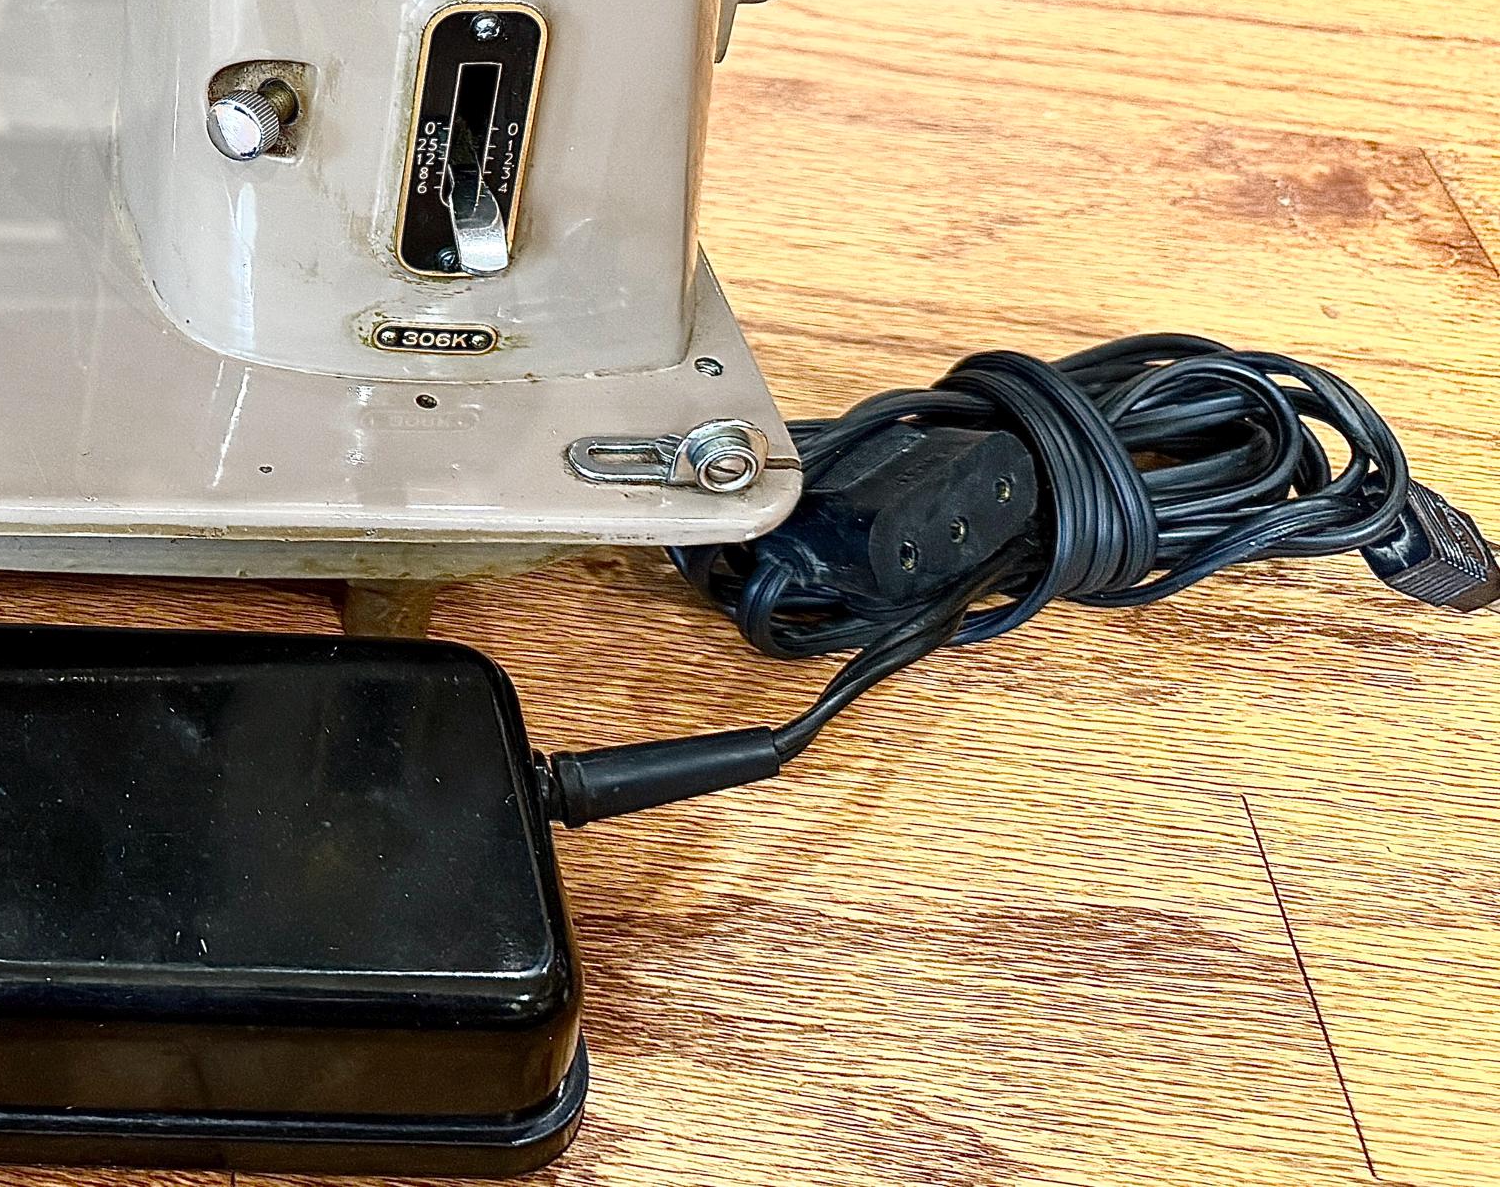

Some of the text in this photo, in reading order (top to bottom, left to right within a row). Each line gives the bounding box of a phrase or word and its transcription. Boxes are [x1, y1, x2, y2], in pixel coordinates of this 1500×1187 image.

[425, 121, 436, 135] 0
[507, 122, 519, 136] 0
[417, 138, 438, 151] 25
[508, 139, 513, 151] 1
[417, 153, 434, 165] 12
[503, 153, 514, 165] 2
[419, 166, 429, 180] 8
[500, 166, 511, 180] 3
[417, 181, 428, 194] 6
[498, 182, 508, 194] 4
[402, 330, 469, 348] 306K
